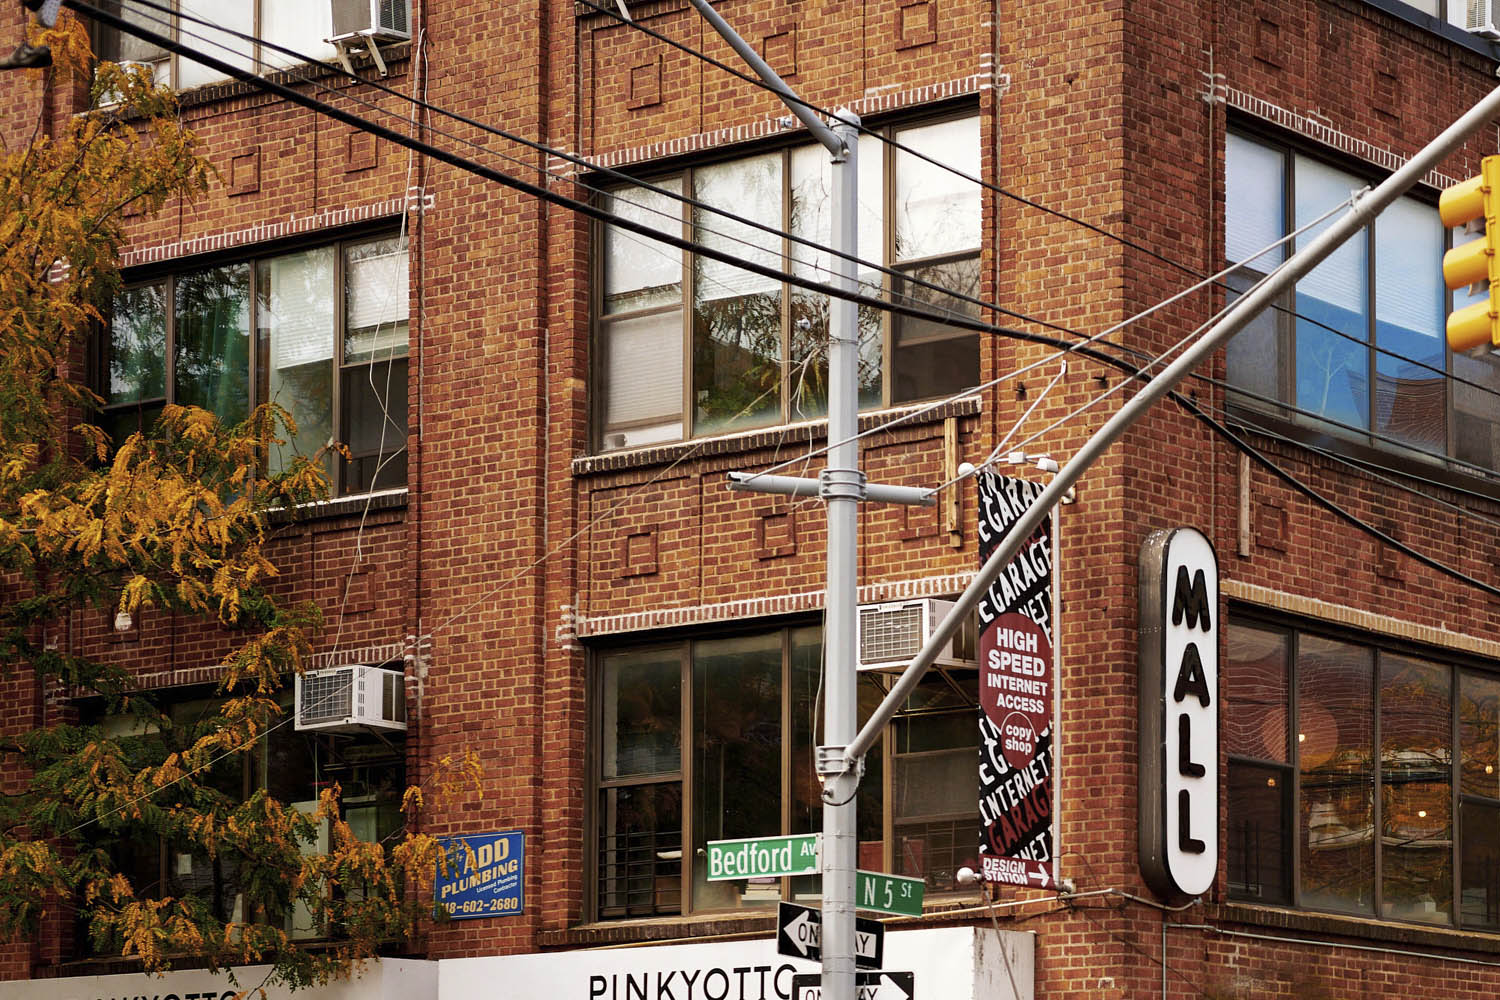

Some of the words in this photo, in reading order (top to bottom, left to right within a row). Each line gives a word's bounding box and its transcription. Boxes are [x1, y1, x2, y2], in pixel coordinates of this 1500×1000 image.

[997, 627, 1038, 653] HIGH
[988, 649, 1045, 677] SPEED
[987, 673, 1048, 696] INTERNET
[997, 693, 1044, 714] ACCESS
[1172, 564, 1211, 854] MALL
[1006, 724, 1032, 742] copy
[1005, 738, 1032, 755] shop
[710, 840, 792, 876] Bedford
[800, 842, 816, 857] Av
[984, 858, 1025, 874] DESIGN
[442, 859, 518, 898] PLUMBING
[984, 871, 1028, 885] STATION
[864, 877, 876, 906] N
[884, 879, 893, 908] 5
[901, 882, 912, 898] St
[441, 897, 518, 913] 18-602-2680
